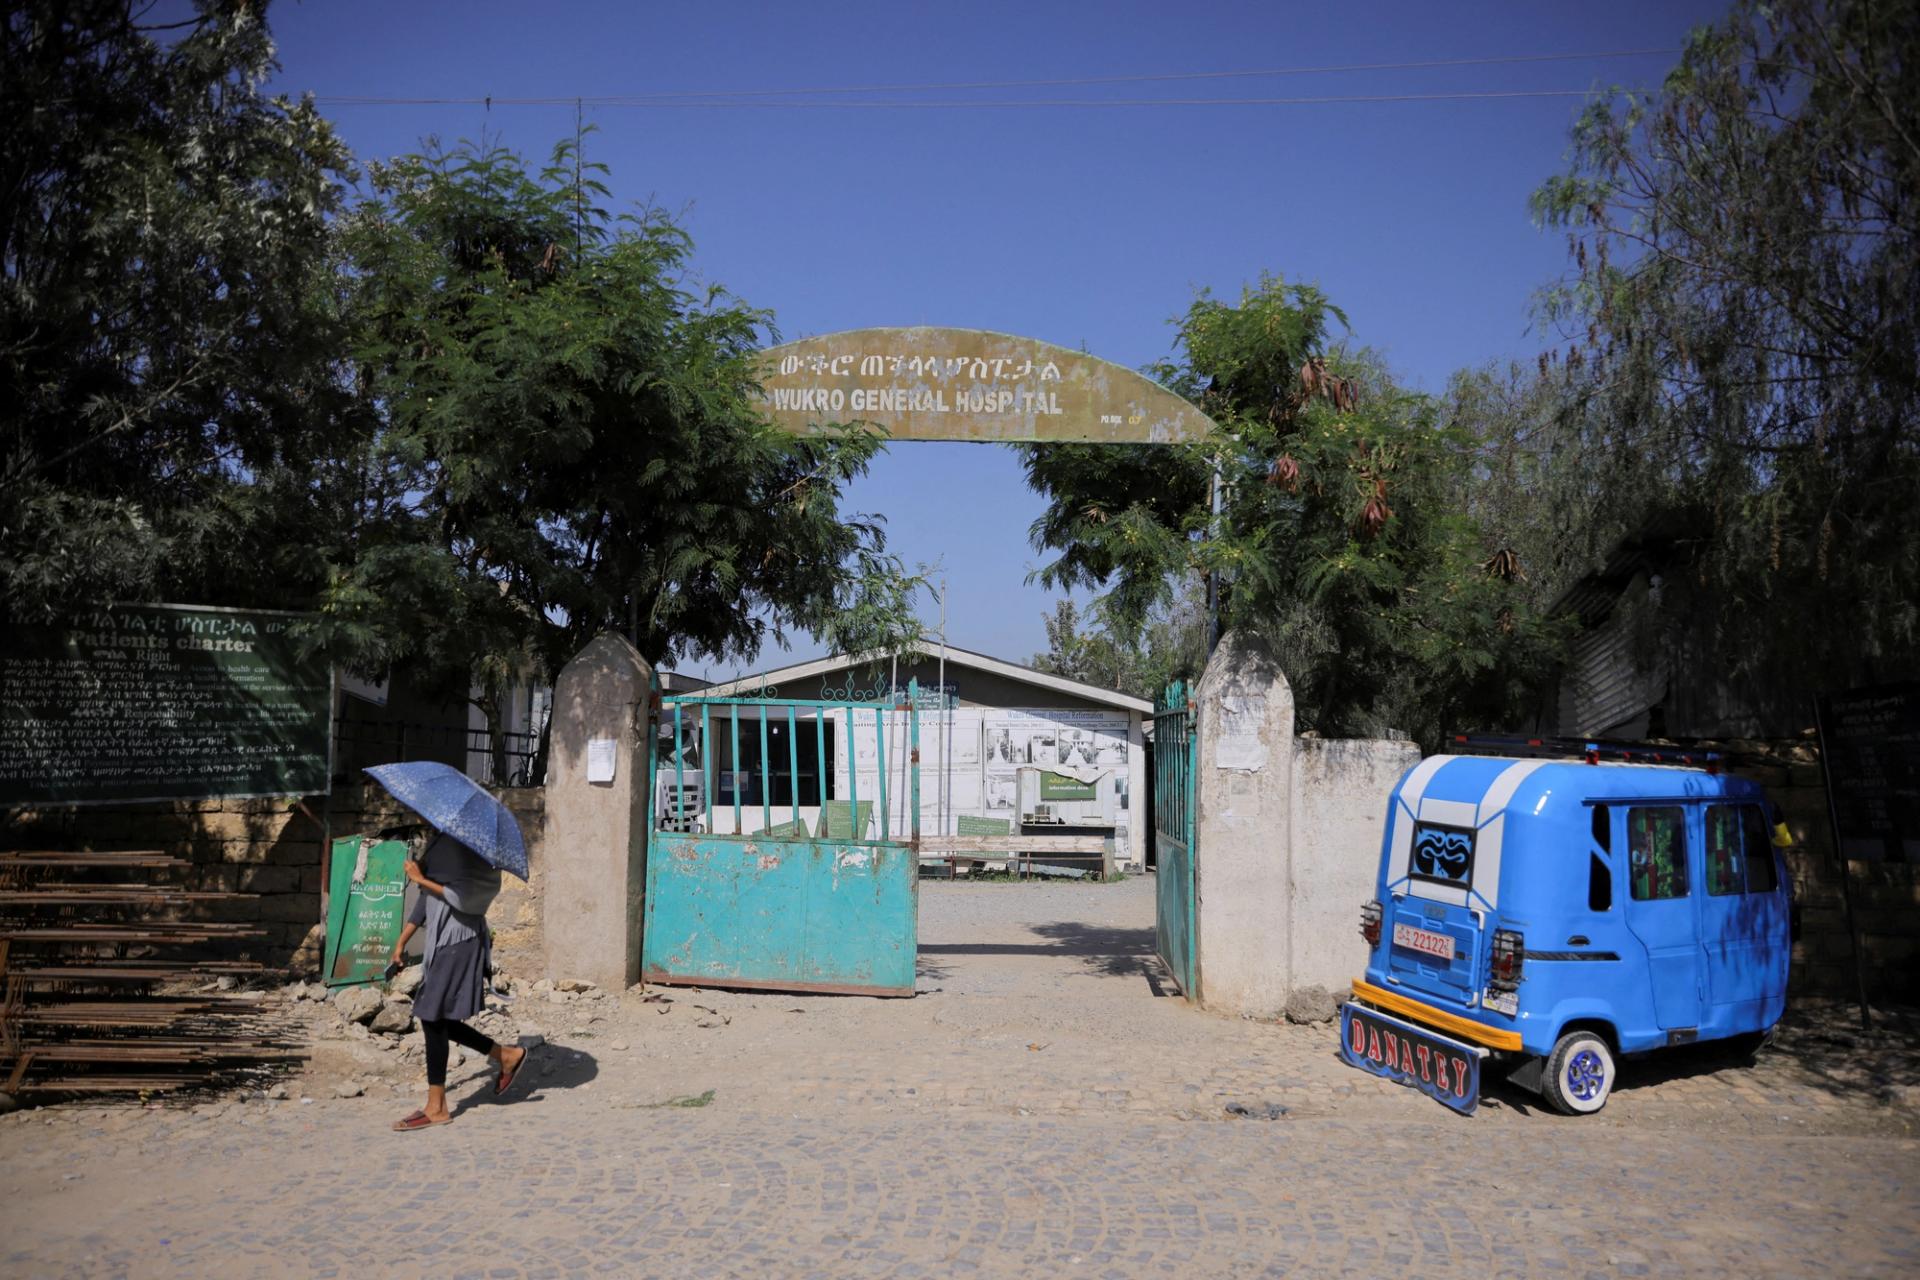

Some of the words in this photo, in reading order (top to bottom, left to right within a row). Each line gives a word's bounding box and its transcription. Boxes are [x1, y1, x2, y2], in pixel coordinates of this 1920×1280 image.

[774, 388, 845, 411] WUKRO
[850, 388, 950, 412] GENERAL
[69, 629, 169, 649] Patients
[176, 634, 256, 654] charter
[136, 649, 171, 664] Right
[1413, 931, 1445, 954] 22122
[1351, 1018, 1468, 1098] DANATEY
